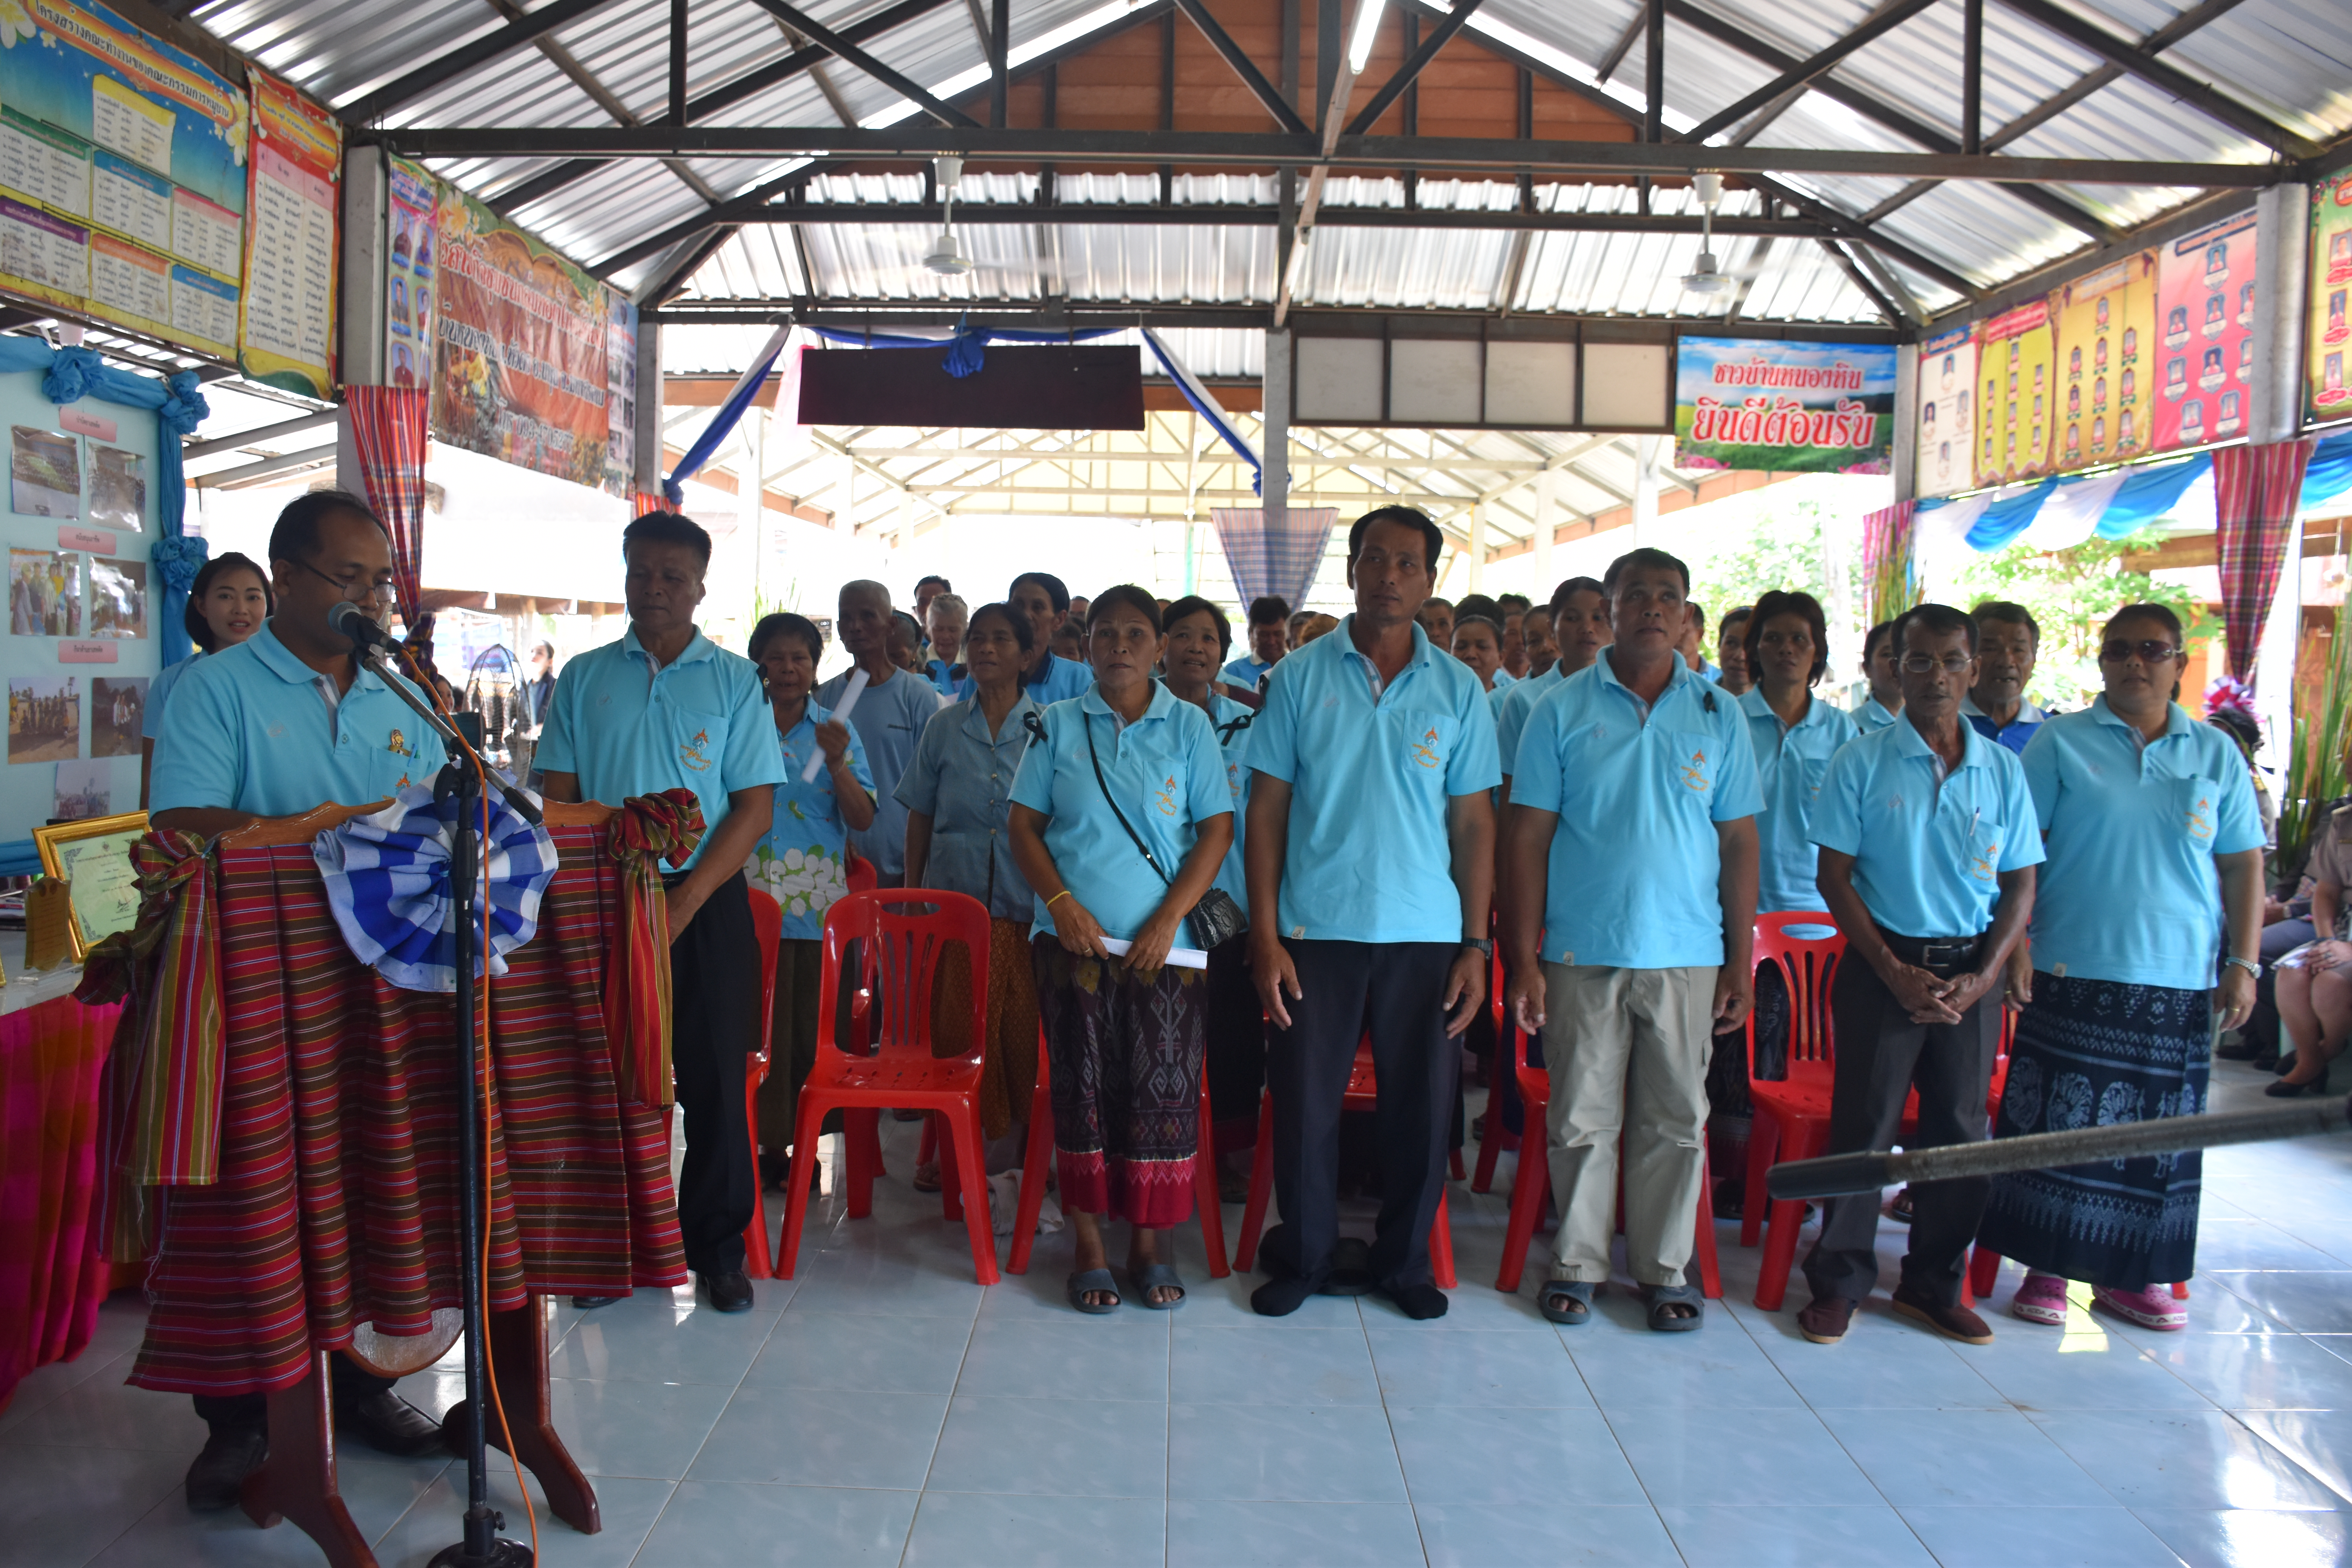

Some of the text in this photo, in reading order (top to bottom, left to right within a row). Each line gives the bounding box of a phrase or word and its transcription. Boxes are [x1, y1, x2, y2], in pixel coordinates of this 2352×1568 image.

[1715, 356, 1862, 390] ชาวบ้านหนองหิน
[1694, 396, 1875, 447] ยินดีต้อนรับ
